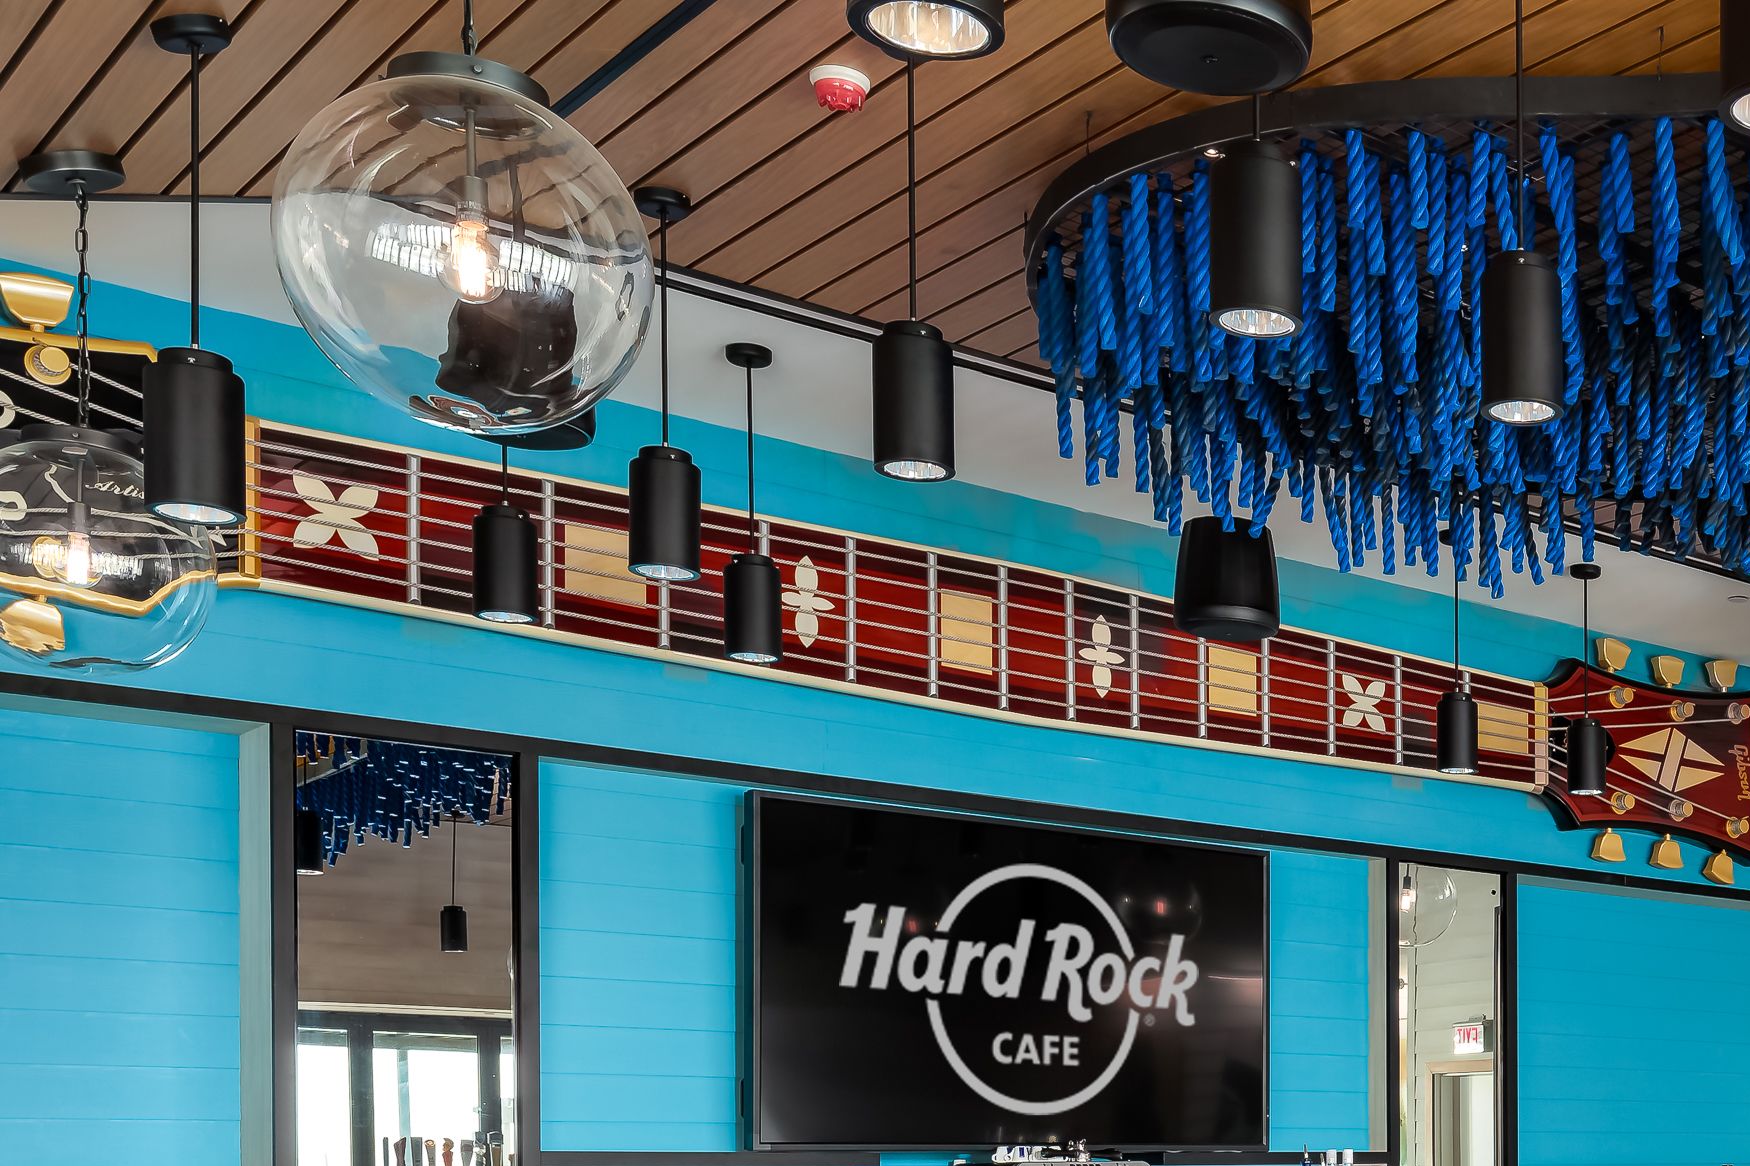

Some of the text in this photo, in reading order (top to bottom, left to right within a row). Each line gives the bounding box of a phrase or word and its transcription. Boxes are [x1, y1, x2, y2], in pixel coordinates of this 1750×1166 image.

[85, 481, 144, 500] Artis
[1728, 744, 1750, 801] Gibson
[839, 903, 1199, 1026] Hard Rock
[991, 1031, 1080, 1066] CAFE
